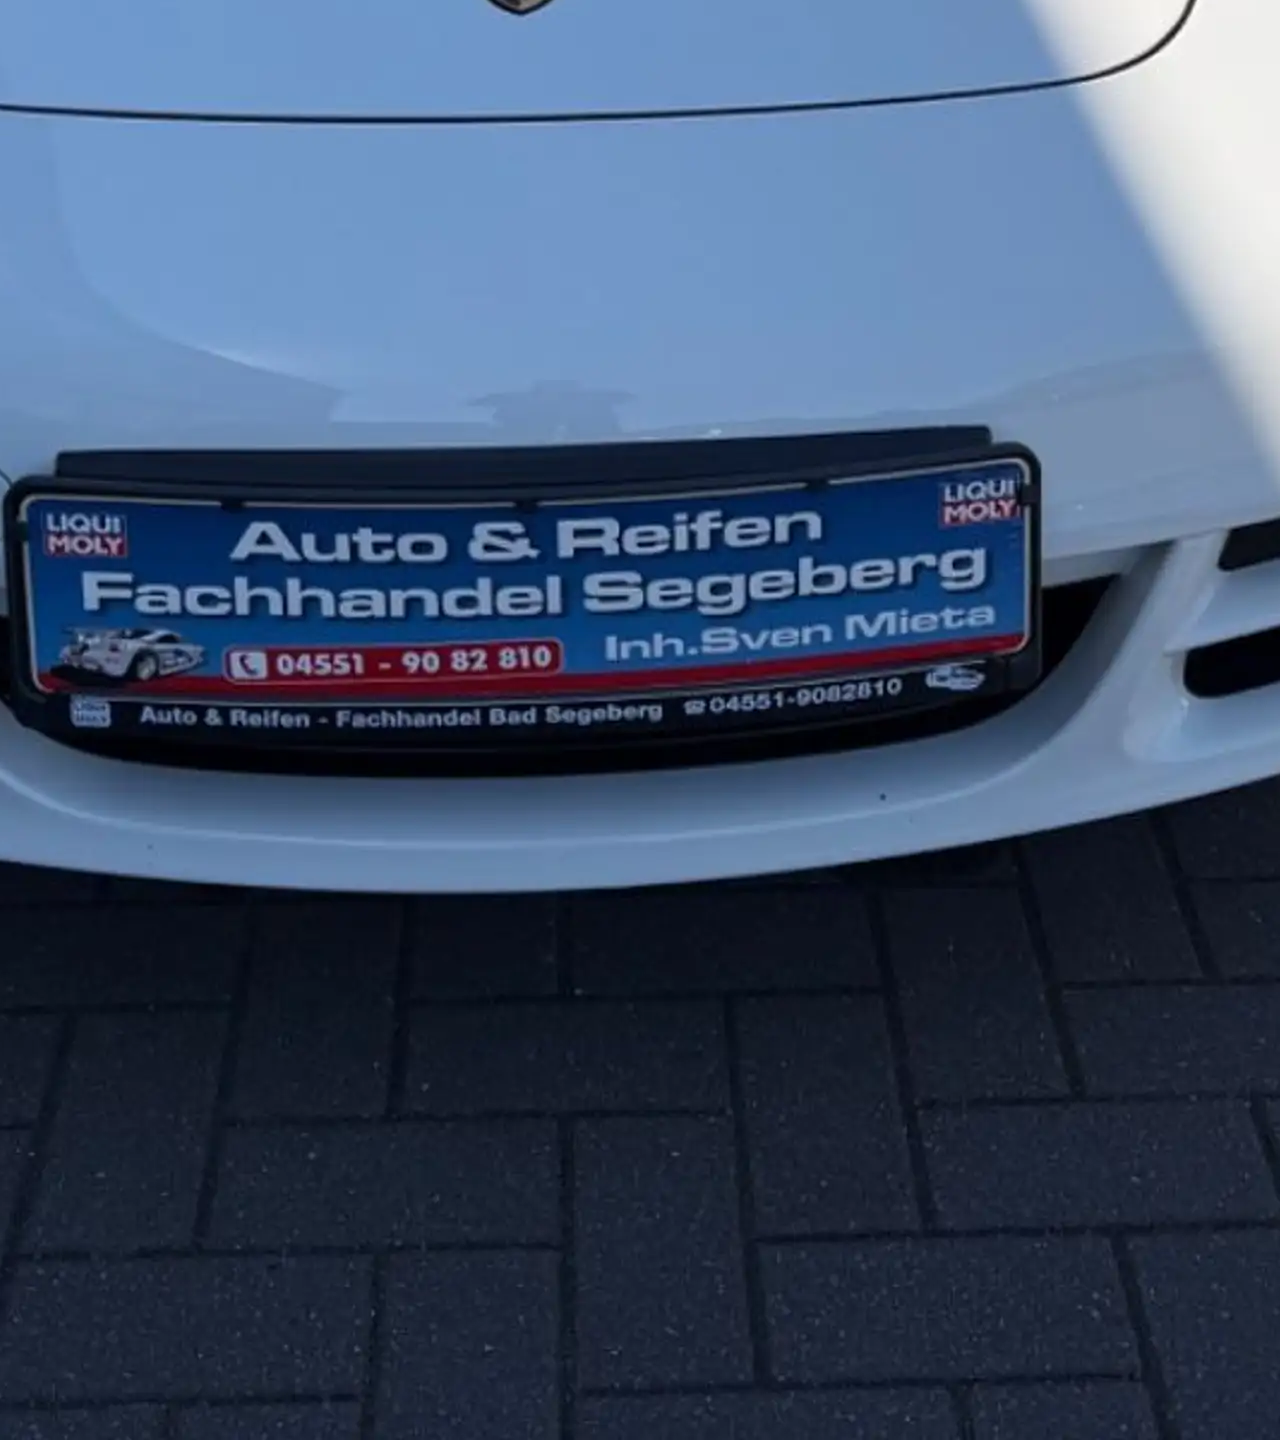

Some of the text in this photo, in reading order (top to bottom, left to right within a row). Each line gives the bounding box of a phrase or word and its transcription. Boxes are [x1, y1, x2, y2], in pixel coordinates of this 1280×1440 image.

[943, 479, 1016, 503] LIQUI
[45, 513, 122, 533] LIQUI
[943, 499, 1019, 525] MOLY
[46, 534, 124, 556] MOLY
[229, 508, 823, 563] Auto & Reifen
[80, 546, 988, 619] Fachhandel Segeberg
[844, 604, 996, 641] Mieta
[276, 652, 365, 676] 04551
[401, 650, 441, 674] 90
[449, 648, 489, 672] 82
[497, 645, 554, 670] 810
[708, 676, 903, 714] 04551-9082810
[139, 705, 198, 726] Auto
[203, 707, 224, 727] &
[229, 707, 311, 728] Reifen
[335, 707, 481, 729] Fachhandel
[488, 706, 538, 726] Bad
[544, 702, 664, 725] Segeberg
